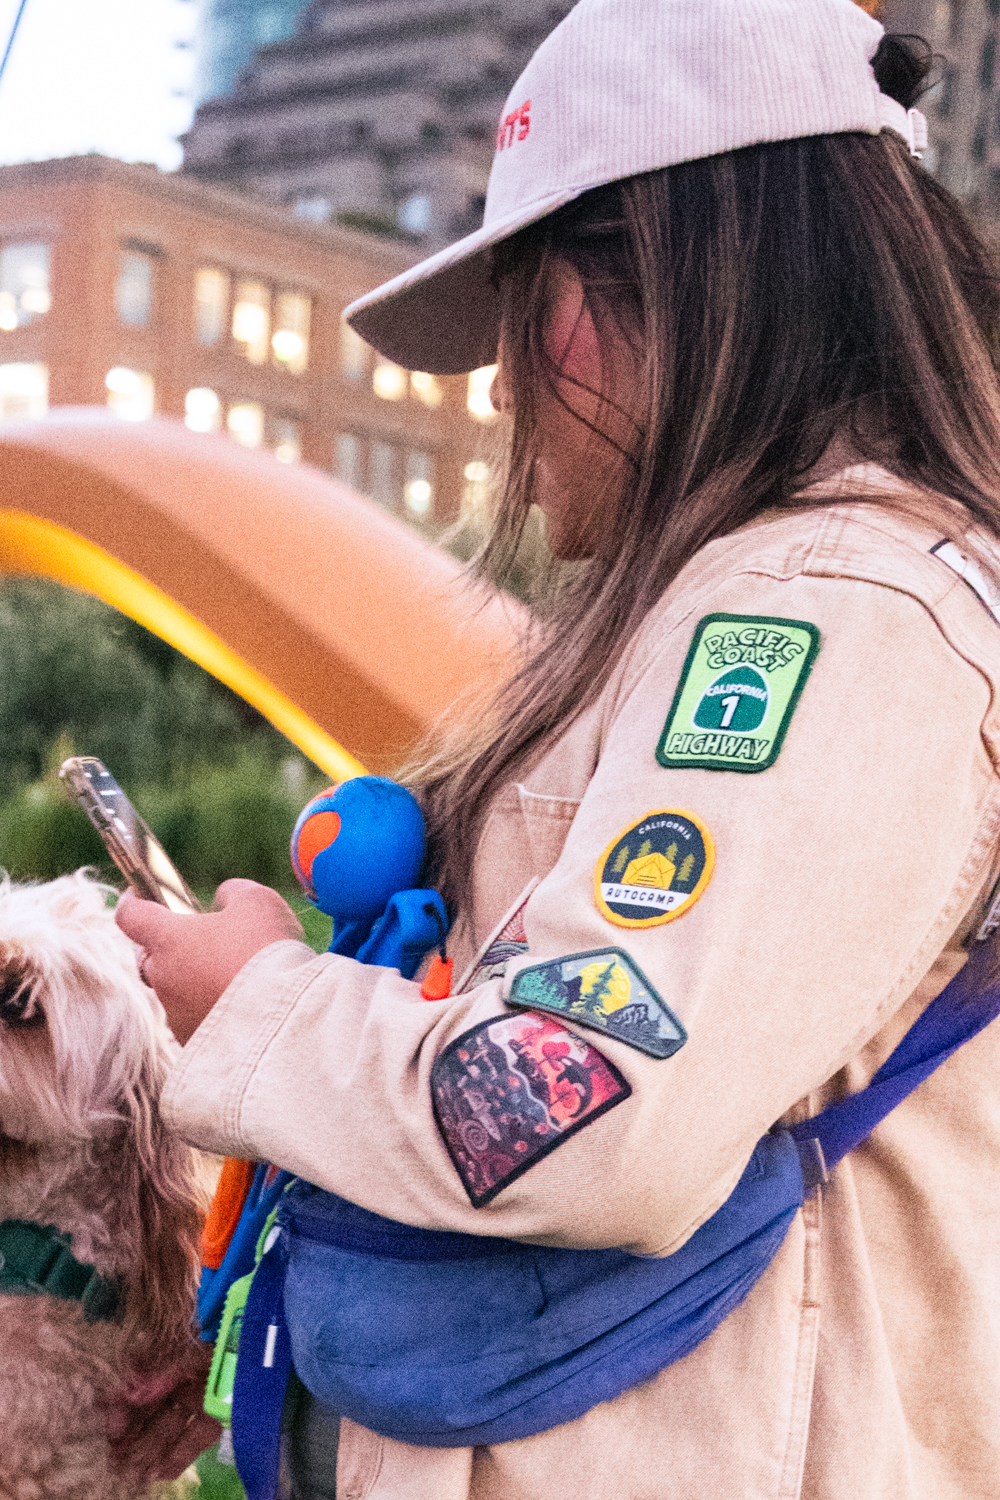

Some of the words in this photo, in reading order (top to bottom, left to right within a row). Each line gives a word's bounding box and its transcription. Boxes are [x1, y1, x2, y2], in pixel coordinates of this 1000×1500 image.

[704, 628, 805, 661] PACIFIC
[706, 646, 790, 673] COAST
[706, 684, 769, 702] CALIFORNIA
[719, 695, 740, 729] 1
[667, 733, 770, 761] HIGHWAY
[638, 820, 692, 841] CALIFORNIA
[605, 887, 675, 905] AUTOCAMP
